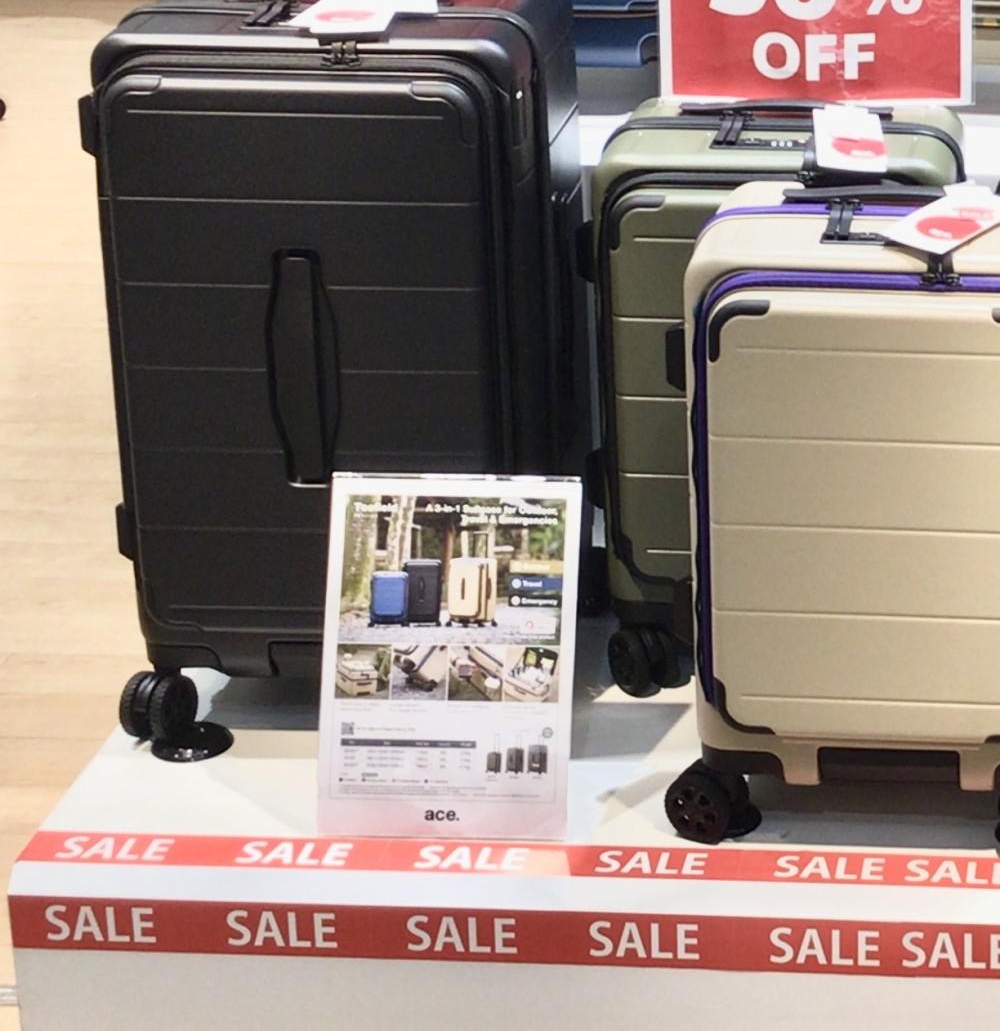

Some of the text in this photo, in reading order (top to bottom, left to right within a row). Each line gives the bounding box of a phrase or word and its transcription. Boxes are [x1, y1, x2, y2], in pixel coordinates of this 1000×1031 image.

[753, 32, 876, 81] OFF
[424, 809, 460, 821] ace.
[55, 835, 175, 862] SALE
[235, 840, 354, 868] SALE
[413, 844, 531, 871] SALE
[596, 851, 708, 876] SALE
[774, 855, 886, 880] SALE
[45, 905, 156, 943] SALE
[227, 910, 338, 948] SALE
[407, 915, 518, 953] SALE
[589, 921, 700, 959] SALE
[769, 927, 880, 966] SALE
